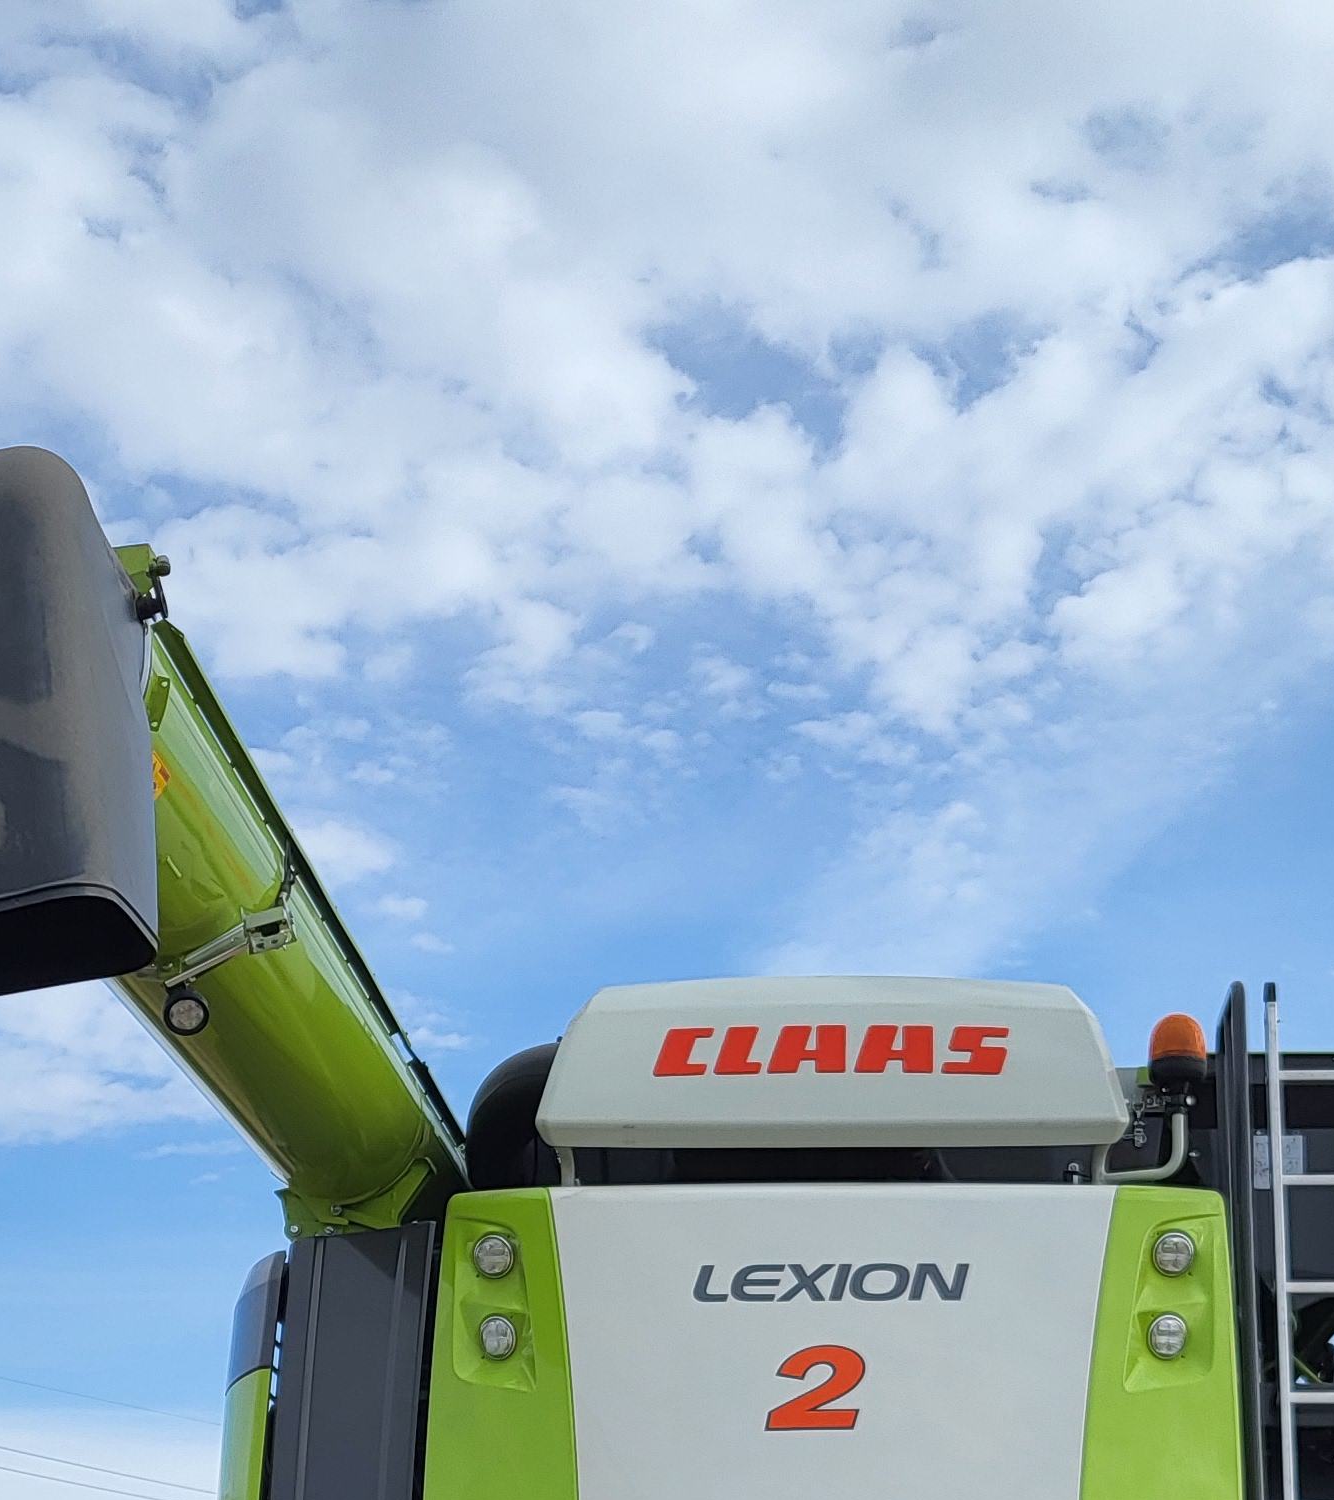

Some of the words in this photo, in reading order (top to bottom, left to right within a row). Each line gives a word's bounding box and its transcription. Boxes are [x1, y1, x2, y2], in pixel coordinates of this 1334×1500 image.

[653, 1024, 1009, 1077] CLAAS
[692, 1262, 970, 1303] LEXION
[764, 1344, 866, 1432] 2
